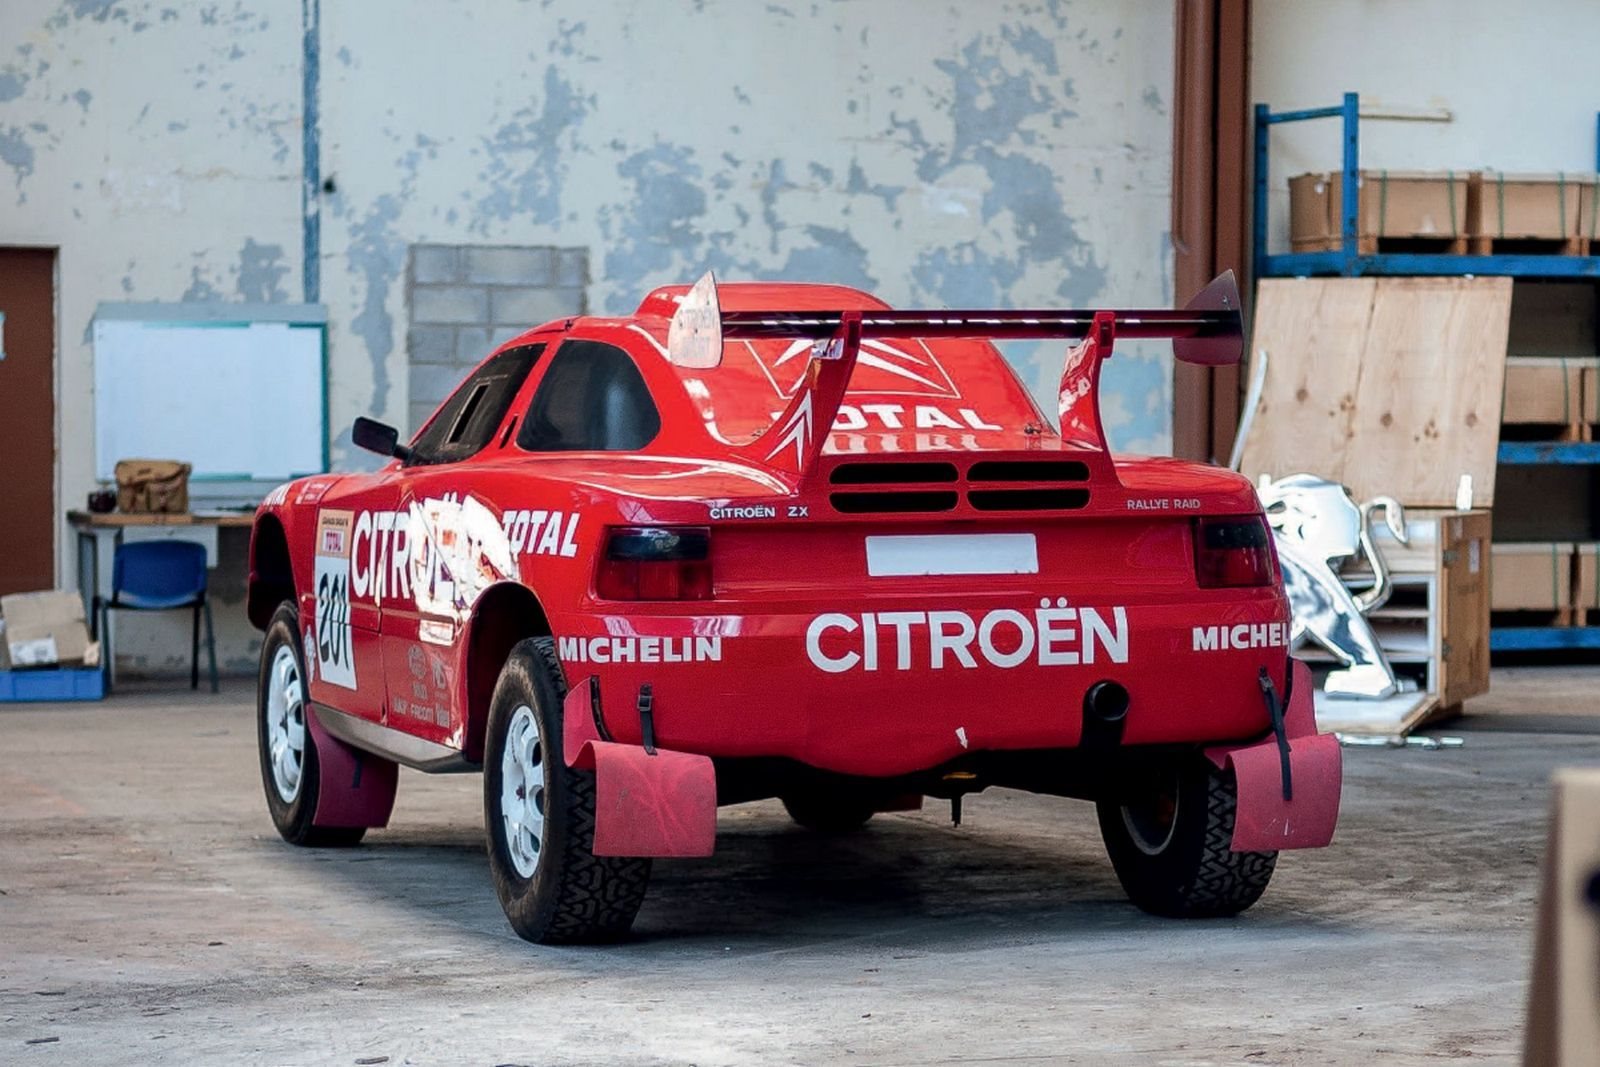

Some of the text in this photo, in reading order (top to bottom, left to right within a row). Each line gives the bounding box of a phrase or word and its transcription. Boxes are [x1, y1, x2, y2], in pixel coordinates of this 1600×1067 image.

[770, 404, 1003, 431] OTAL
[709, 505, 809, 519] CITROËN ZX
[1127, 498, 1201, 510] RALLYE RAID
[502, 510, 580, 558] TOTAL
[319, 573, 350, 669] 201
[806, 597, 1128, 672] CITROËN
[559, 636, 722, 664] MICHELIN
